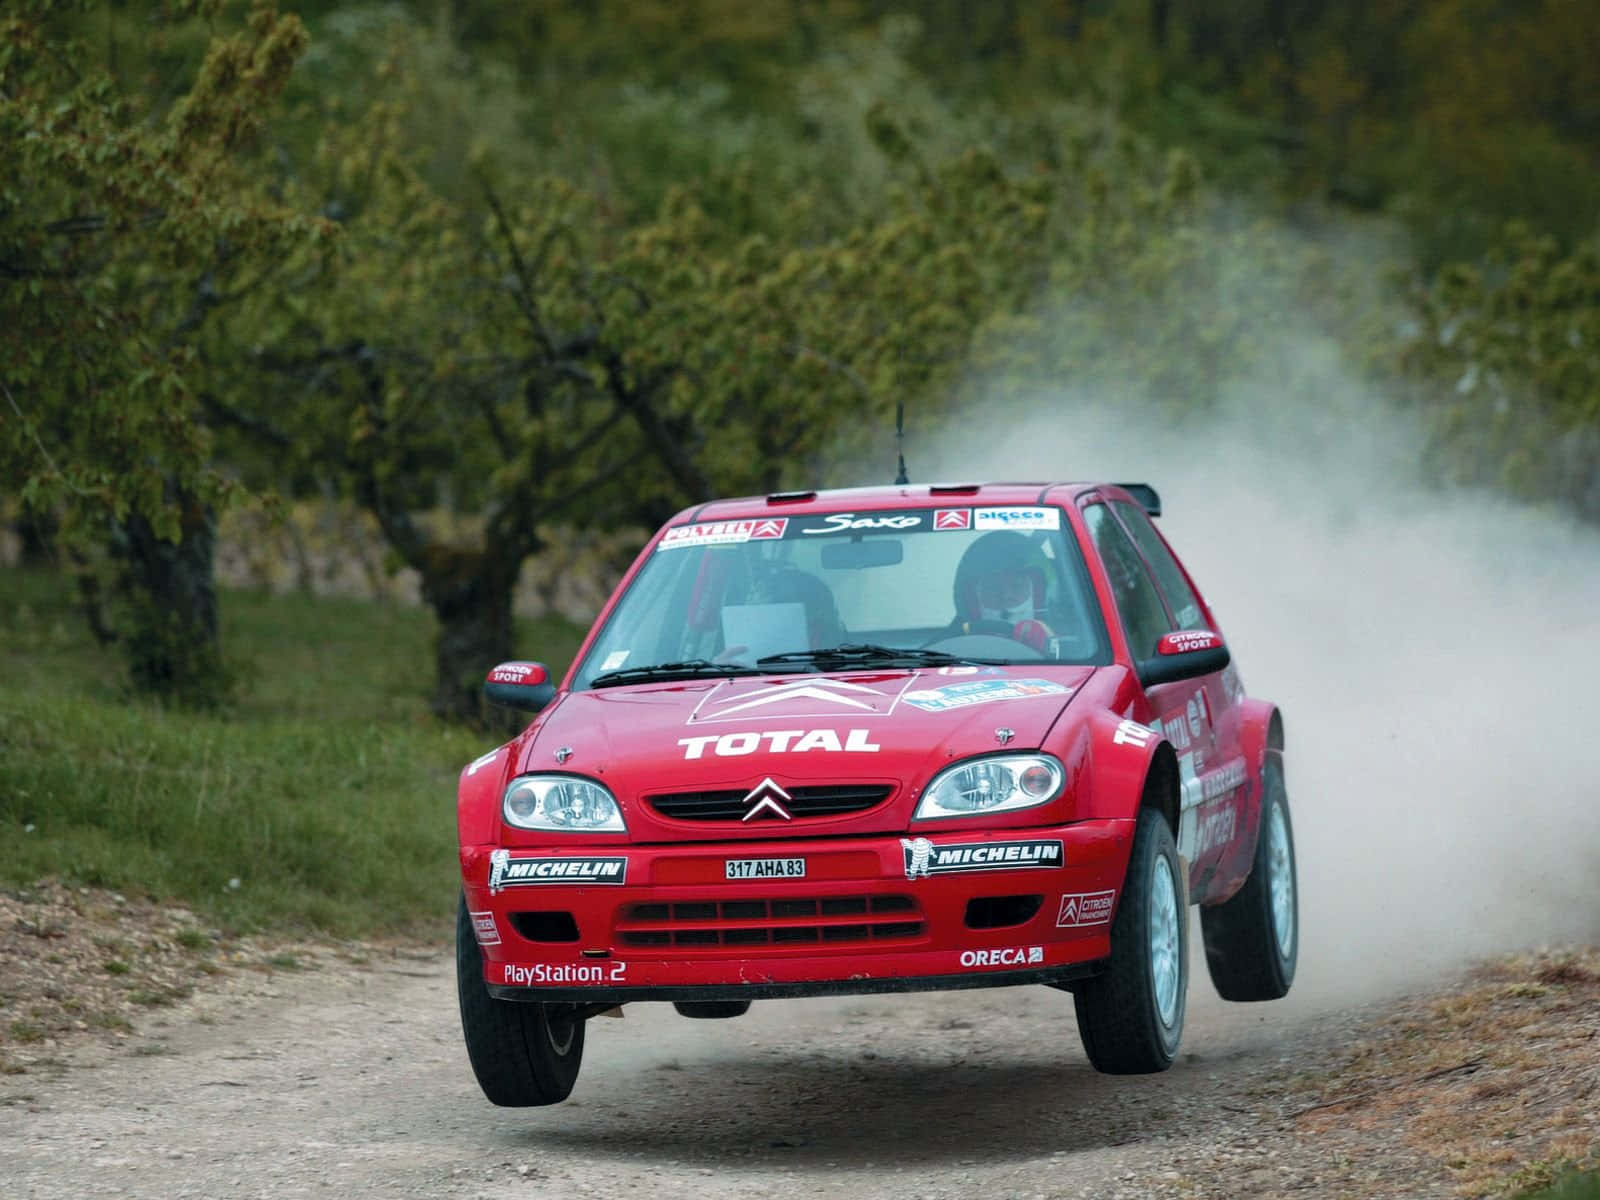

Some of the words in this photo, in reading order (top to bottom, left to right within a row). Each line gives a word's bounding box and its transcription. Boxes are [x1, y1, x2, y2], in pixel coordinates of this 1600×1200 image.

[802, 513, 922, 534] Saxo
[1177, 639, 1211, 652] SPORT
[494, 672, 524, 683] SPORT
[677, 728, 881, 760] TOTAL
[937, 845, 1060, 865] MICHELIN
[507, 861, 622, 877] MICHELIN
[727, 860, 751, 877] 317
[755, 860, 783, 877] AHA
[786, 859, 804, 876] 83
[959, 948, 1027, 967] ORECA
